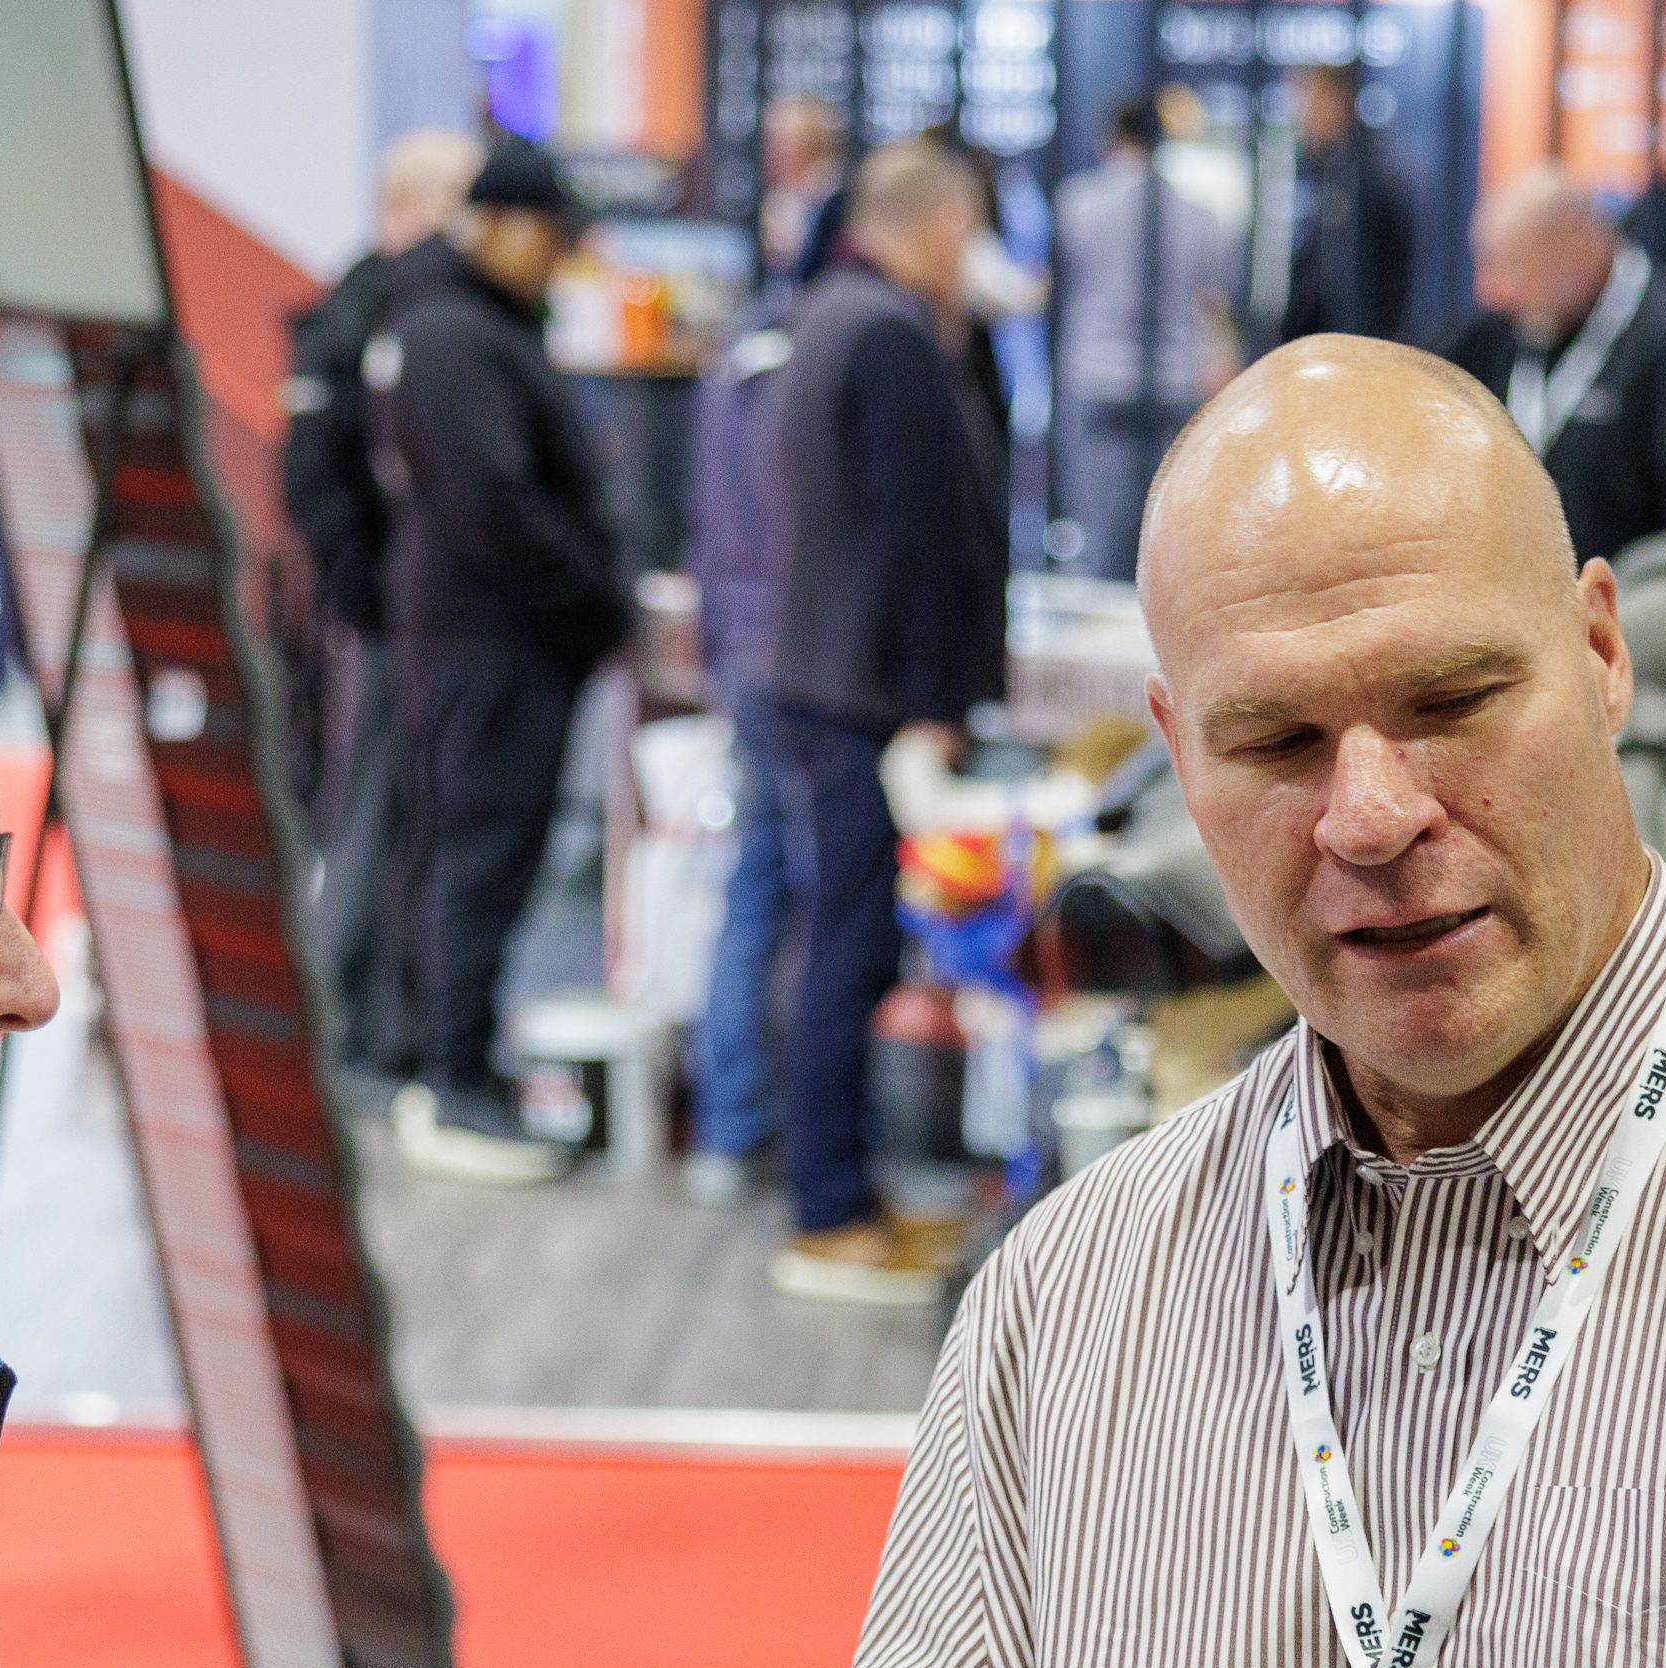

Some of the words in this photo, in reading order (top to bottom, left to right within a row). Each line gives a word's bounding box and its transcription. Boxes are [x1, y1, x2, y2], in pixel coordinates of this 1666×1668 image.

[1584, 1189, 1619, 1256] Construction
[1590, 1186, 1610, 1217] Week
[1296, 1323, 1320, 1396] MERS
[1510, 1326, 1557, 1400] MERS
[1319, 1466, 1340, 1535] Construction
[1456, 1470, 1493, 1538] Construction
[1462, 1466, 1484, 1496] Week
[1335, 1499, 1350, 1532] Week
